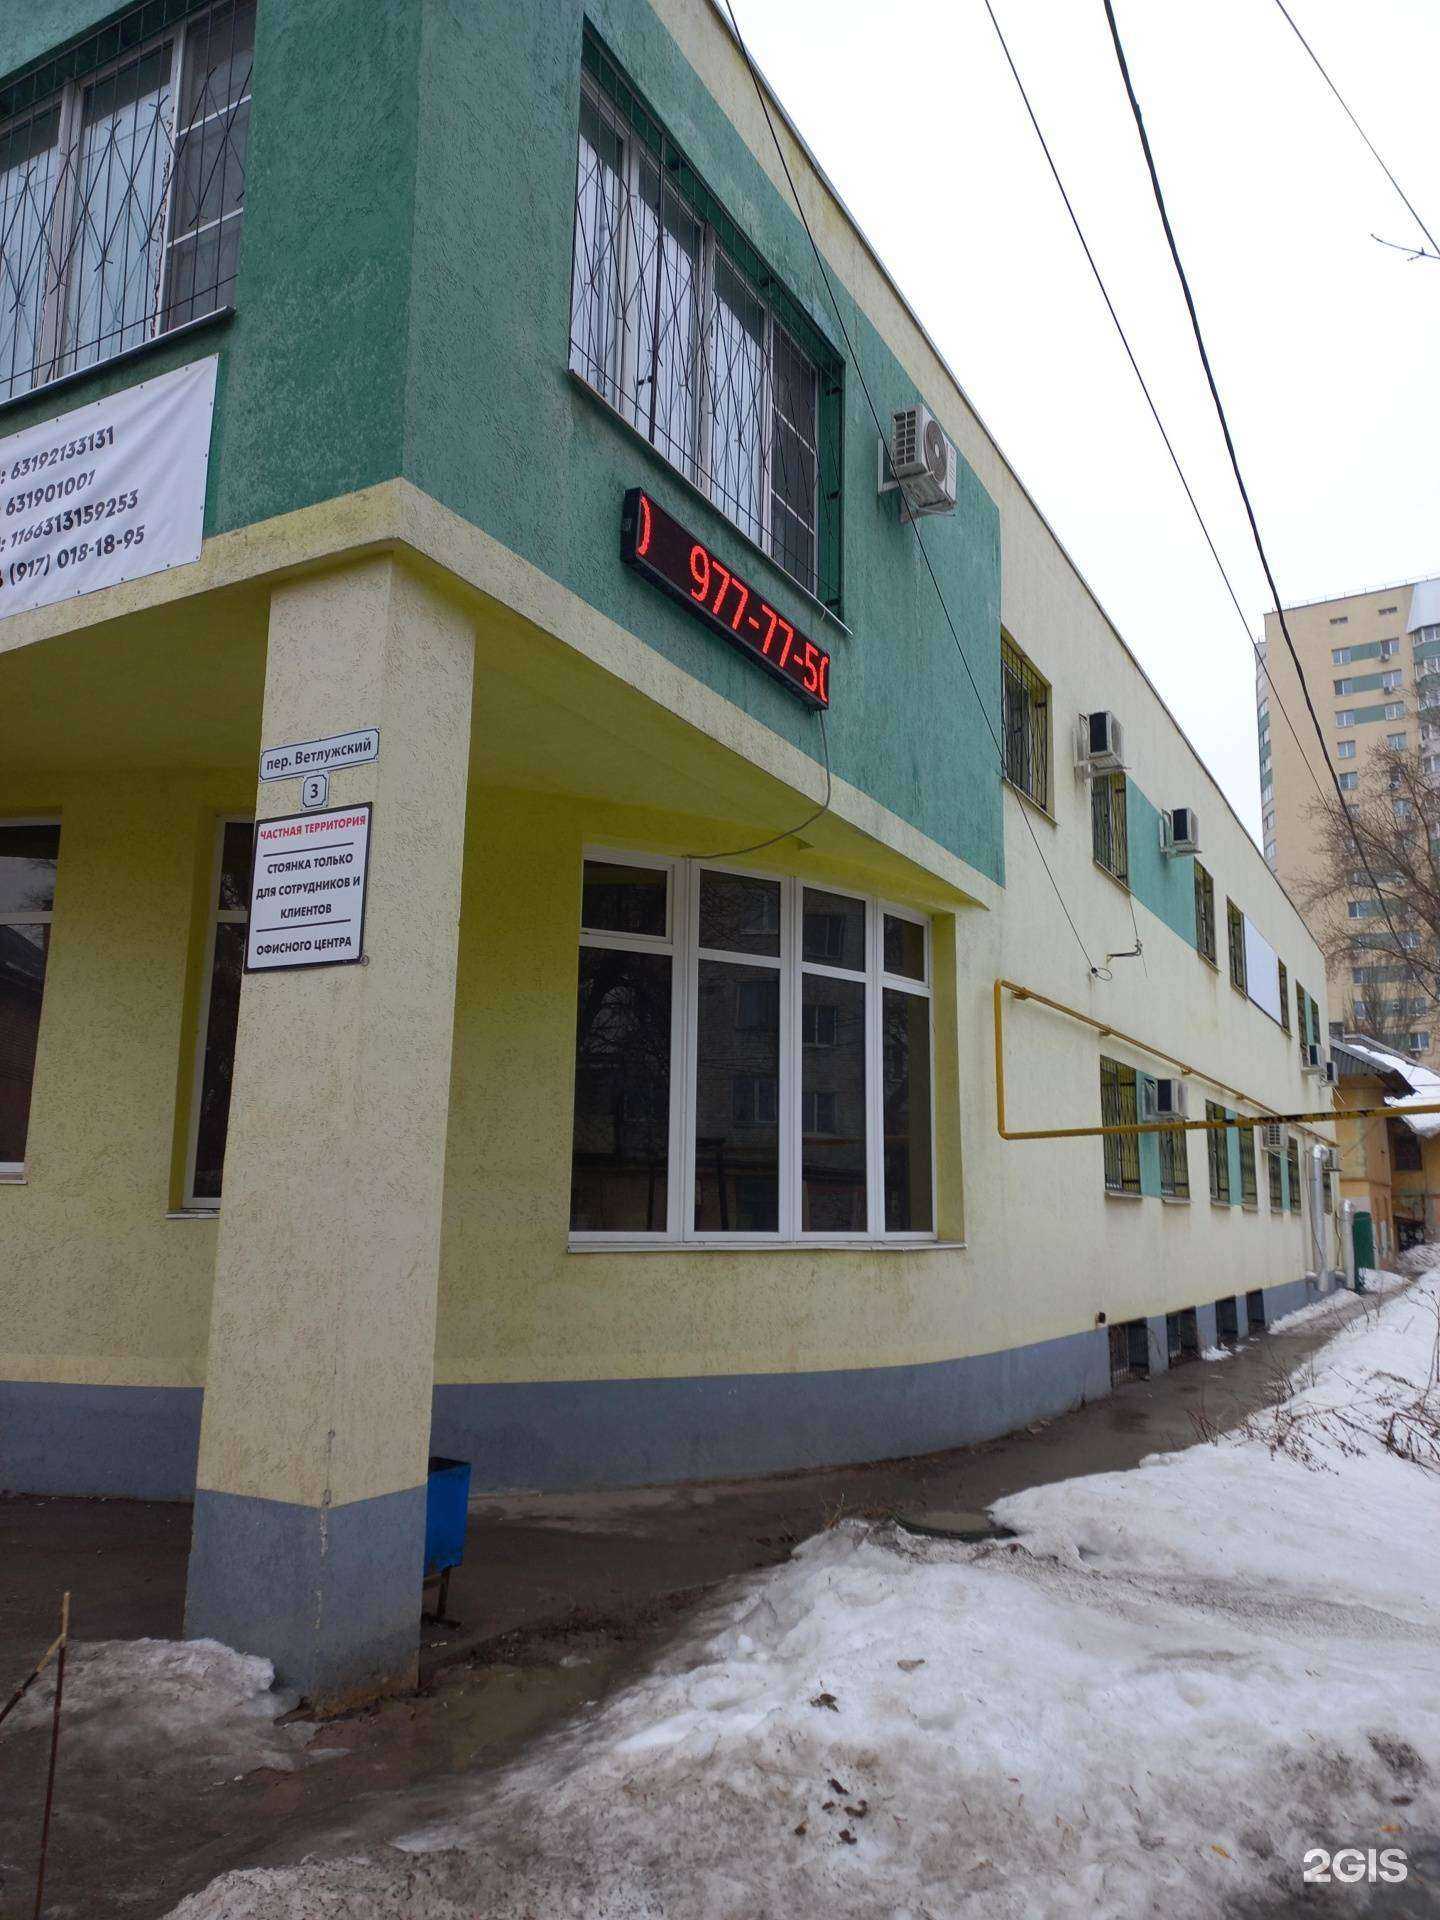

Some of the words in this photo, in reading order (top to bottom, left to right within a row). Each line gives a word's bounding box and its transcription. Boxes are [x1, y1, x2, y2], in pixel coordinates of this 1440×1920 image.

[5, 469, 96, 516] 631901001
[11, 488, 139, 548] 1166313159253
[9, 553, 51, 586] (917)
[56, 524, 146, 569] 018-18-95
[266, 755, 292, 771] пер.
[295, 737, 372, 766] Ветлужский
[309, 783, 319, 799] 3
[260, 822, 303, 840] ЧАСТНАЯ
[305, 815, 366, 834] ТЕРРИТОРИЯ
[267, 859, 311, 874] СТОЯНКА
[313, 852, 354, 869] ТОЛЬКО
[256, 884, 277, 900] ДЛЯ
[278, 878, 351, 896] СОТРУДНИКОВ
[352, 875, 361, 886] И
[280, 903, 333, 919] КЛИЕНТОВ
[256, 939, 311, 956] ОФИСНОГО
[314, 936, 352, 952] ЦЕНТРА
